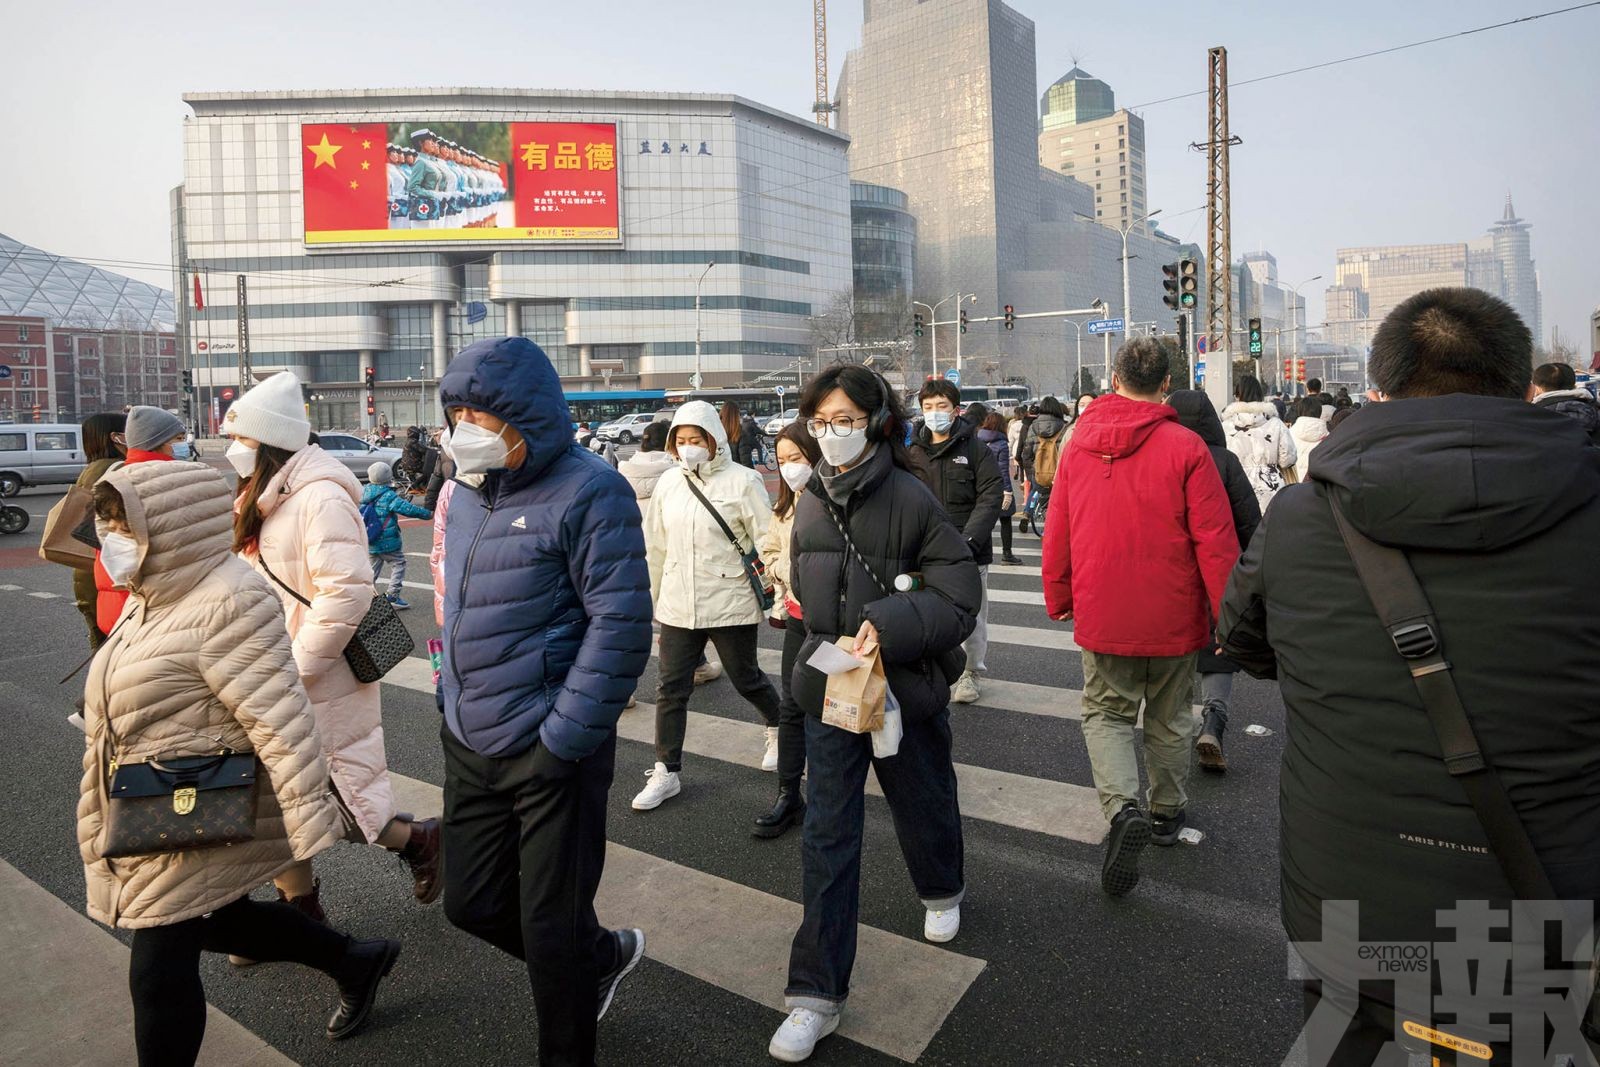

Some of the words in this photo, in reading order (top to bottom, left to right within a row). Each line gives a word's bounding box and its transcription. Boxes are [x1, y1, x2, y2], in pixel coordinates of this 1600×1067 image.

[520, 142, 615, 171] 有品德
[1250, 342, 1261, 352] 22
[316, 389, 356, 399] UAWEI
[384, 387, 424, 397] HUAWE
[1399, 833, 1435, 846] PARIS
